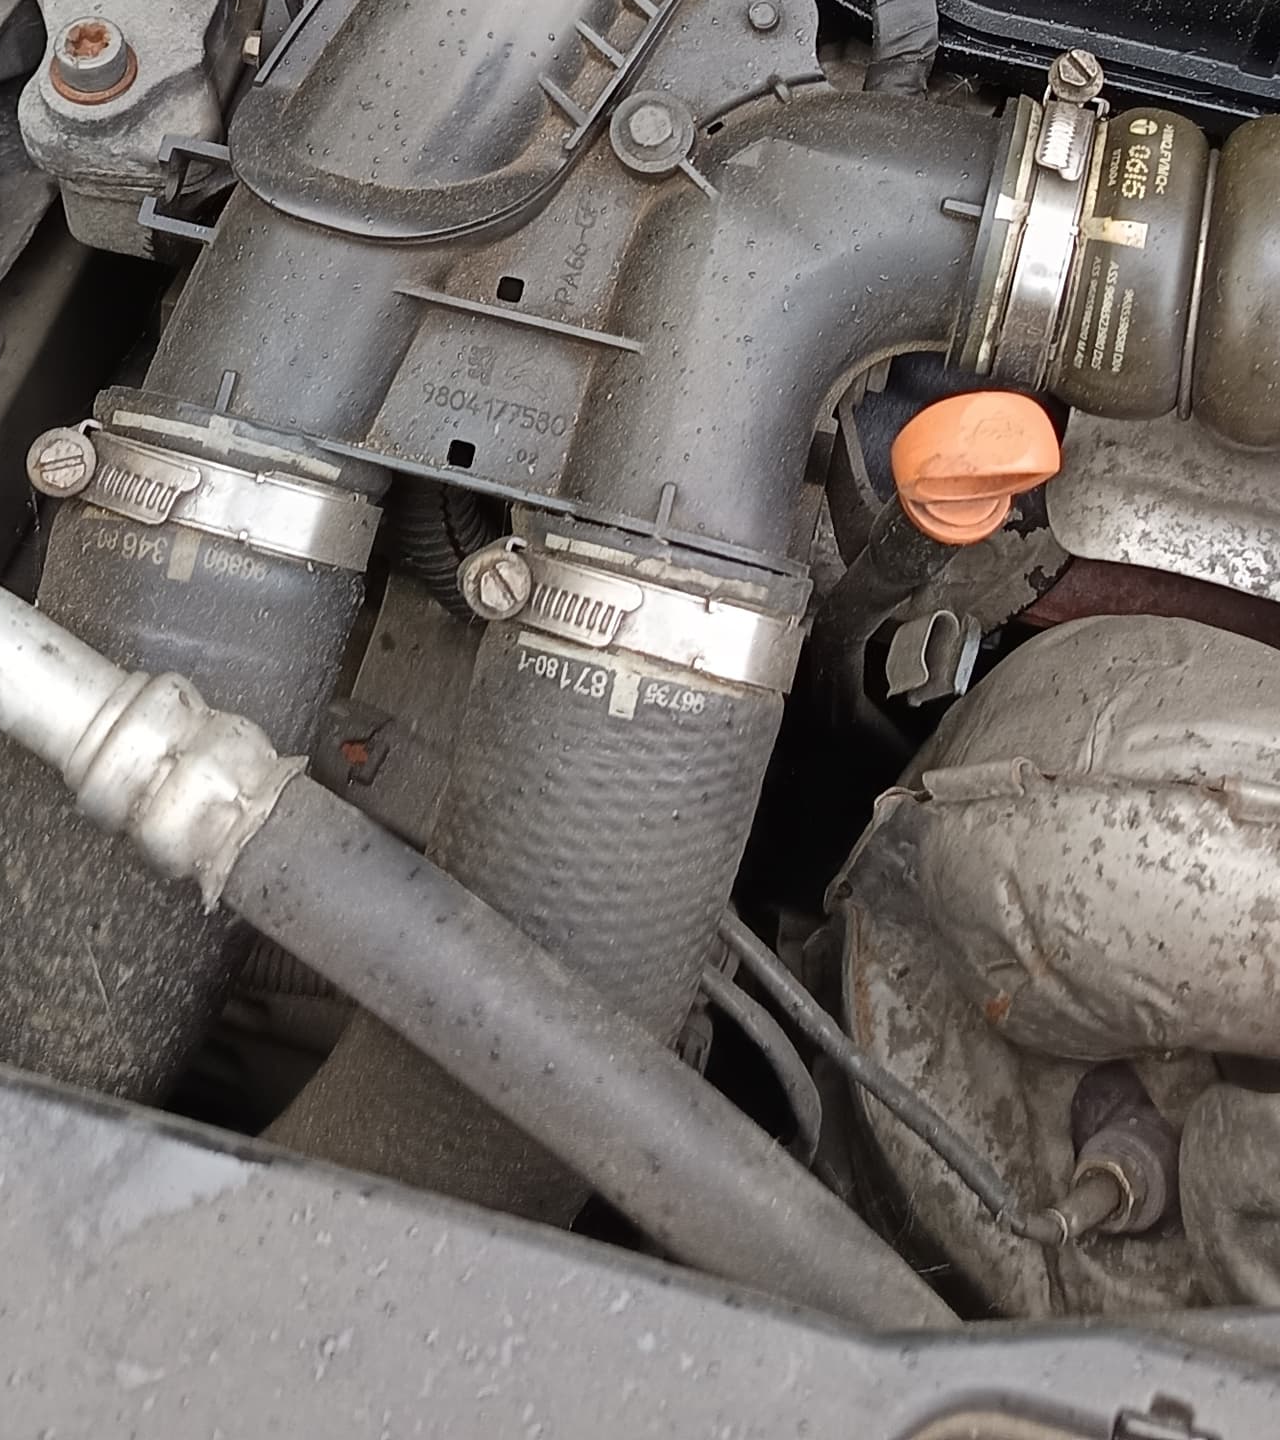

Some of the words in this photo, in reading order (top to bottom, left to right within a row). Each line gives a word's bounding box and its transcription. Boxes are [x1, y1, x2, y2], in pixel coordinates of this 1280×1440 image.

[1122, 144, 1151, 200] 0615
[1091, 255, 1102, 278] ASS
[1106, 260, 1120, 285] ASS
[422, 382, 567, 438] 9804177580
[643, 682, 705, 714] 96735
